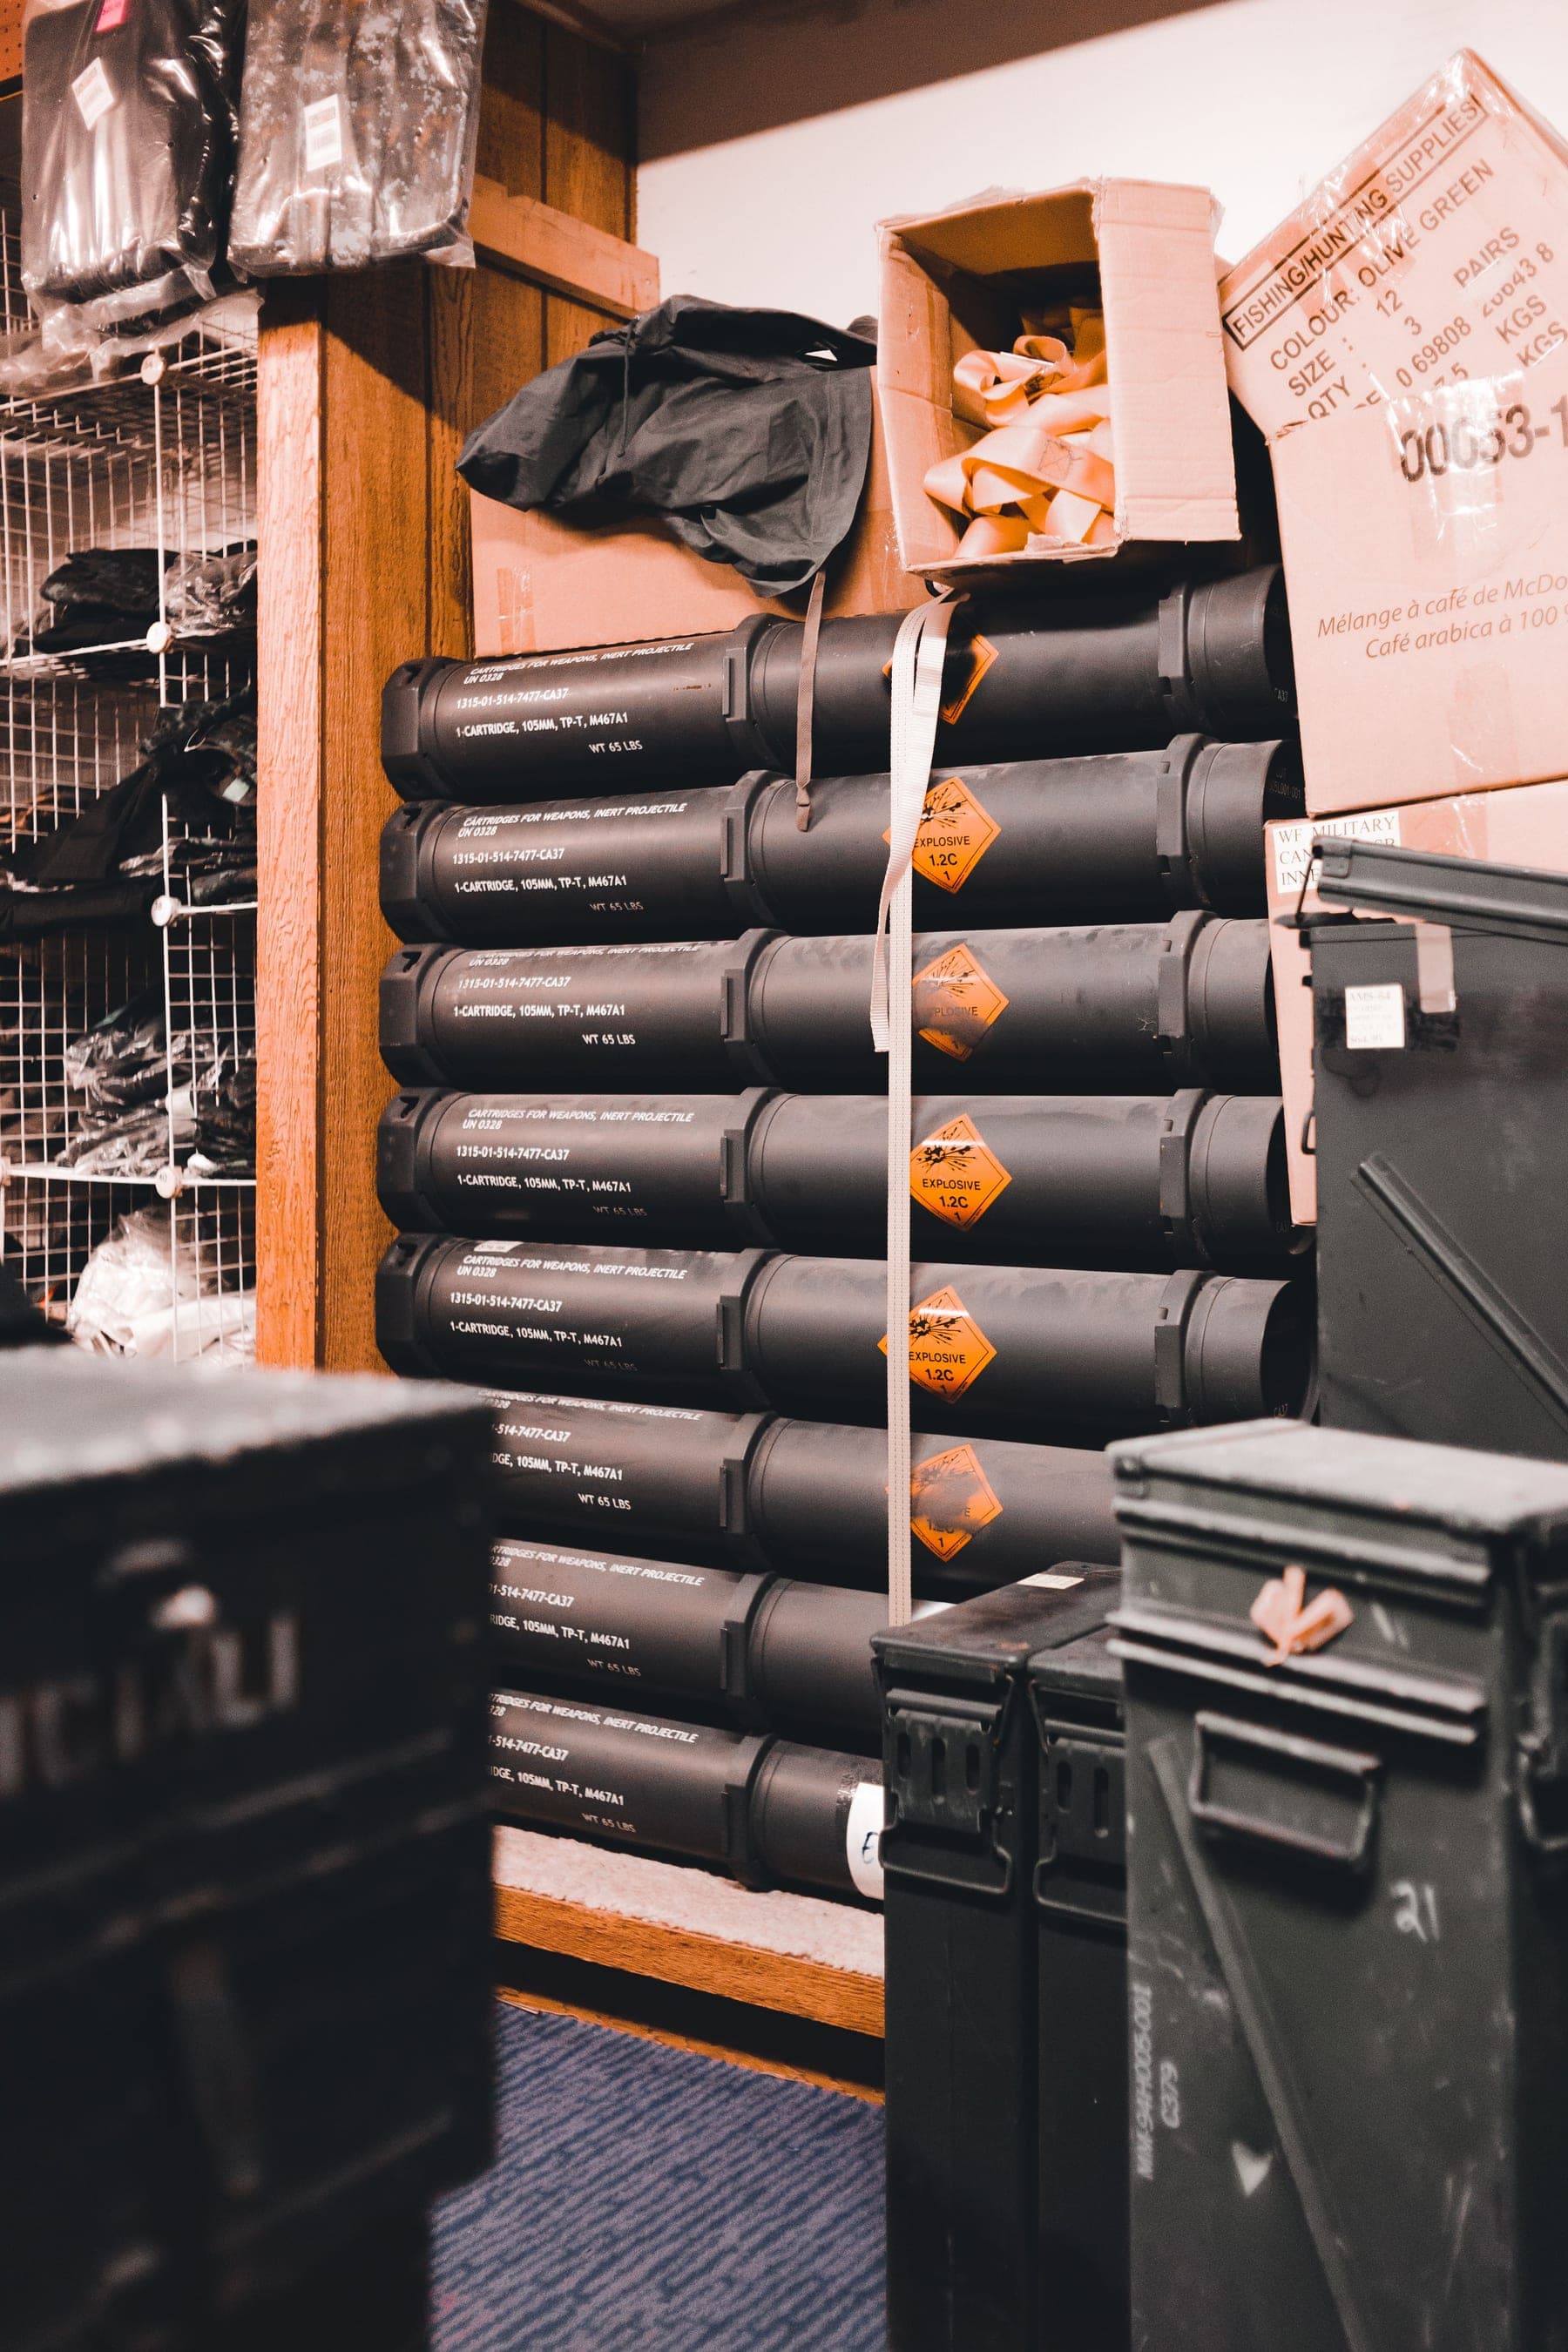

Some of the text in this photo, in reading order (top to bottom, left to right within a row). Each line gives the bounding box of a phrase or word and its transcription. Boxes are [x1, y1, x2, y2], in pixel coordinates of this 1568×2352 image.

[1385, 101, 1477, 193] SUPPLIES
[1358, 225, 1421, 287] OLIVE
[1419, 158, 1495, 230] GREEN
[1308, 226, 1520, 419] QTY 3 PAIRS
[1396, 367, 1413, 388] 0
[1411, 316, 1471, 374] 69808
[1536, 242, 1554, 262] 8
[1495, 294, 1547, 344] KGS
[1288, 289, 1402, 396] SIZE 12
[1516, 321, 1568, 367] KGS
[1317, 607, 1402, 638] Mélange
[1408, 599, 1419, 618] à
[1425, 586, 1468, 616] café
[1473, 585, 1498, 605] de
[1366, 606, 1558, 659] Café arabica à 100
[470, 663, 527, 675] CARTRIDGES
[550, 654, 598, 666] WEAPONS,
[601, 651, 631, 659] INERT
[628, 643, 694, 657] PROJECTILE
[463, 672, 504, 684] UN 0328
[457, 688, 569, 709] 1315-01-514-7477-CA37
[456, 712, 627, 737] 1-CARTRIDGE, 105MM, TP-T, M467A1
[589, 740, 643, 754] WT 65 LBS
[463, 803, 687, 827] CARTRIDGES FOR WEAPONS, INERT PROJECTILE
[458, 827, 497, 837] UN 0328
[1312, 816, 1395, 836] MILITARY
[915, 836, 970, 848] EXPLOSIVE
[453, 848, 564, 864] 1315-01-514-7477-CA37
[929, 854, 957, 866] 1.2C
[455, 875, 626, 893] 1-CARTRIDGE, 105MM, TP-T, M467A1
[943, 871, 950, 881] 1
[625, 902, 644, 910] LBS
[458, 977, 571, 988] 1315-01-514-7477-CA37
[454, 1004, 625, 1018] 1-CARTRIDGE, 105MM, TP-T, M467A1
[582, 1034, 635, 1044] WT 65 LBS
[463, 1119, 502, 1130] UN 0328
[468, 1110, 524, 1119] CARTRIDGES
[526, 1111, 547, 1119] FOR
[549, 1112, 597, 1121] WEAPONS,
[632, 1112, 694, 1122] PROJECTILE
[456, 1146, 569, 1160] 1315-01-514-7477-CA37
[457, 1175, 632, 1193] 1-CARTRIDGE, 105MM, TP-T, M467A1
[923, 1179, 981, 1191] EXPLOSIVE
[939, 1196, 969, 1208] 1.2C
[954, 1212, 961, 1221] 1
[457, 1266, 497, 1278] UN 0328
[463, 1254, 688, 1280] CARTRIDGES FOR WEAPONS, INERT PROJECTILE
[450, 1292, 563, 1313] 1315-01-514-7477-CA37
[450, 1321, 622, 1347] 1-CARTRIDGE, 105MM, TP-T, M467A1
[909, 1351, 966, 1364] EXPLOSIVE
[925, 1369, 954, 1382] 1.2C
[640, 1406, 702, 1421] PROJECTILE
[517, 1456, 552, 1472] 105MM,
[555, 1460, 581, 1477] TP-T,
[584, 1464, 623, 1481] M467A1
[578, 1493, 632, 1510] WT 65 LBS
[938, 1538, 943, 1547] 1
[537, 1552, 558, 1562] FOR
[558, 1555, 606, 1572] WEAPONS,
[610, 1564, 641, 1576] INERT
[641, 1568, 705, 1586] PROJECTILE
[523, 1619, 558, 1638] 105MM,
[561, 1625, 588, 1643] TP-T,
[591, 1632, 630, 1649] M467A1
[587, 1659, 641, 1677] WT 65 LBS
[531, 1701, 551, 1713] FOR
[552, 1705, 601, 1725] WEAPONS,
[604, 1717, 636, 1730] INERT
[634, 1722, 699, 1743] PROJECTILE
[517, 1771, 553, 1791] 105MM,
[556, 1780, 583, 1798] TP-T,
[585, 1788, 625, 1806] M467A1
